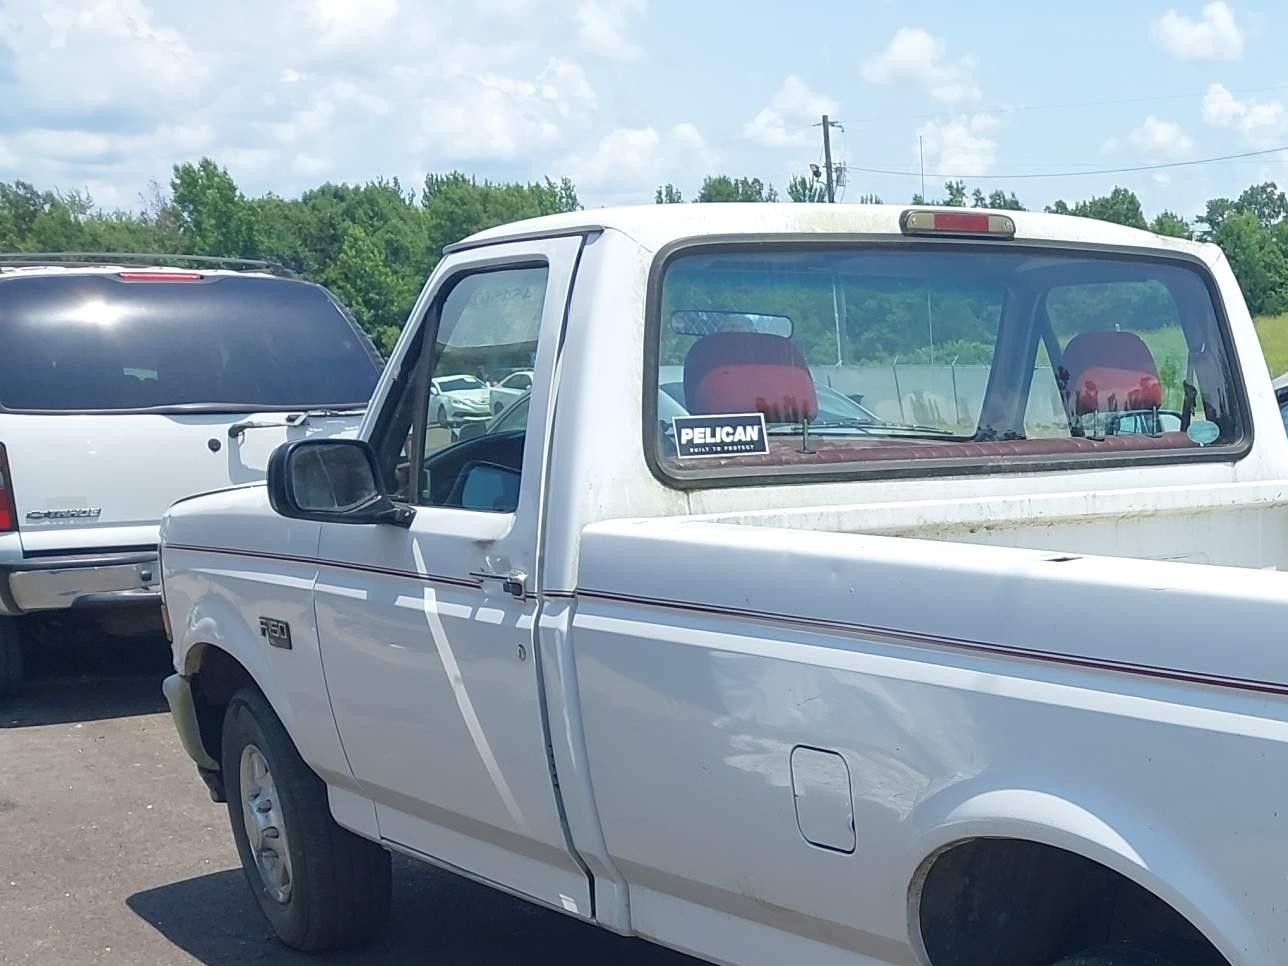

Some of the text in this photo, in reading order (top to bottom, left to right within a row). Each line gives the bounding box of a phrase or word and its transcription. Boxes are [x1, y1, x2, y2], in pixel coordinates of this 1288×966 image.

[681, 425, 759, 445] PELICAN
[689, 446, 709, 454] BUILT
[724, 444, 755, 452] PROTECT
